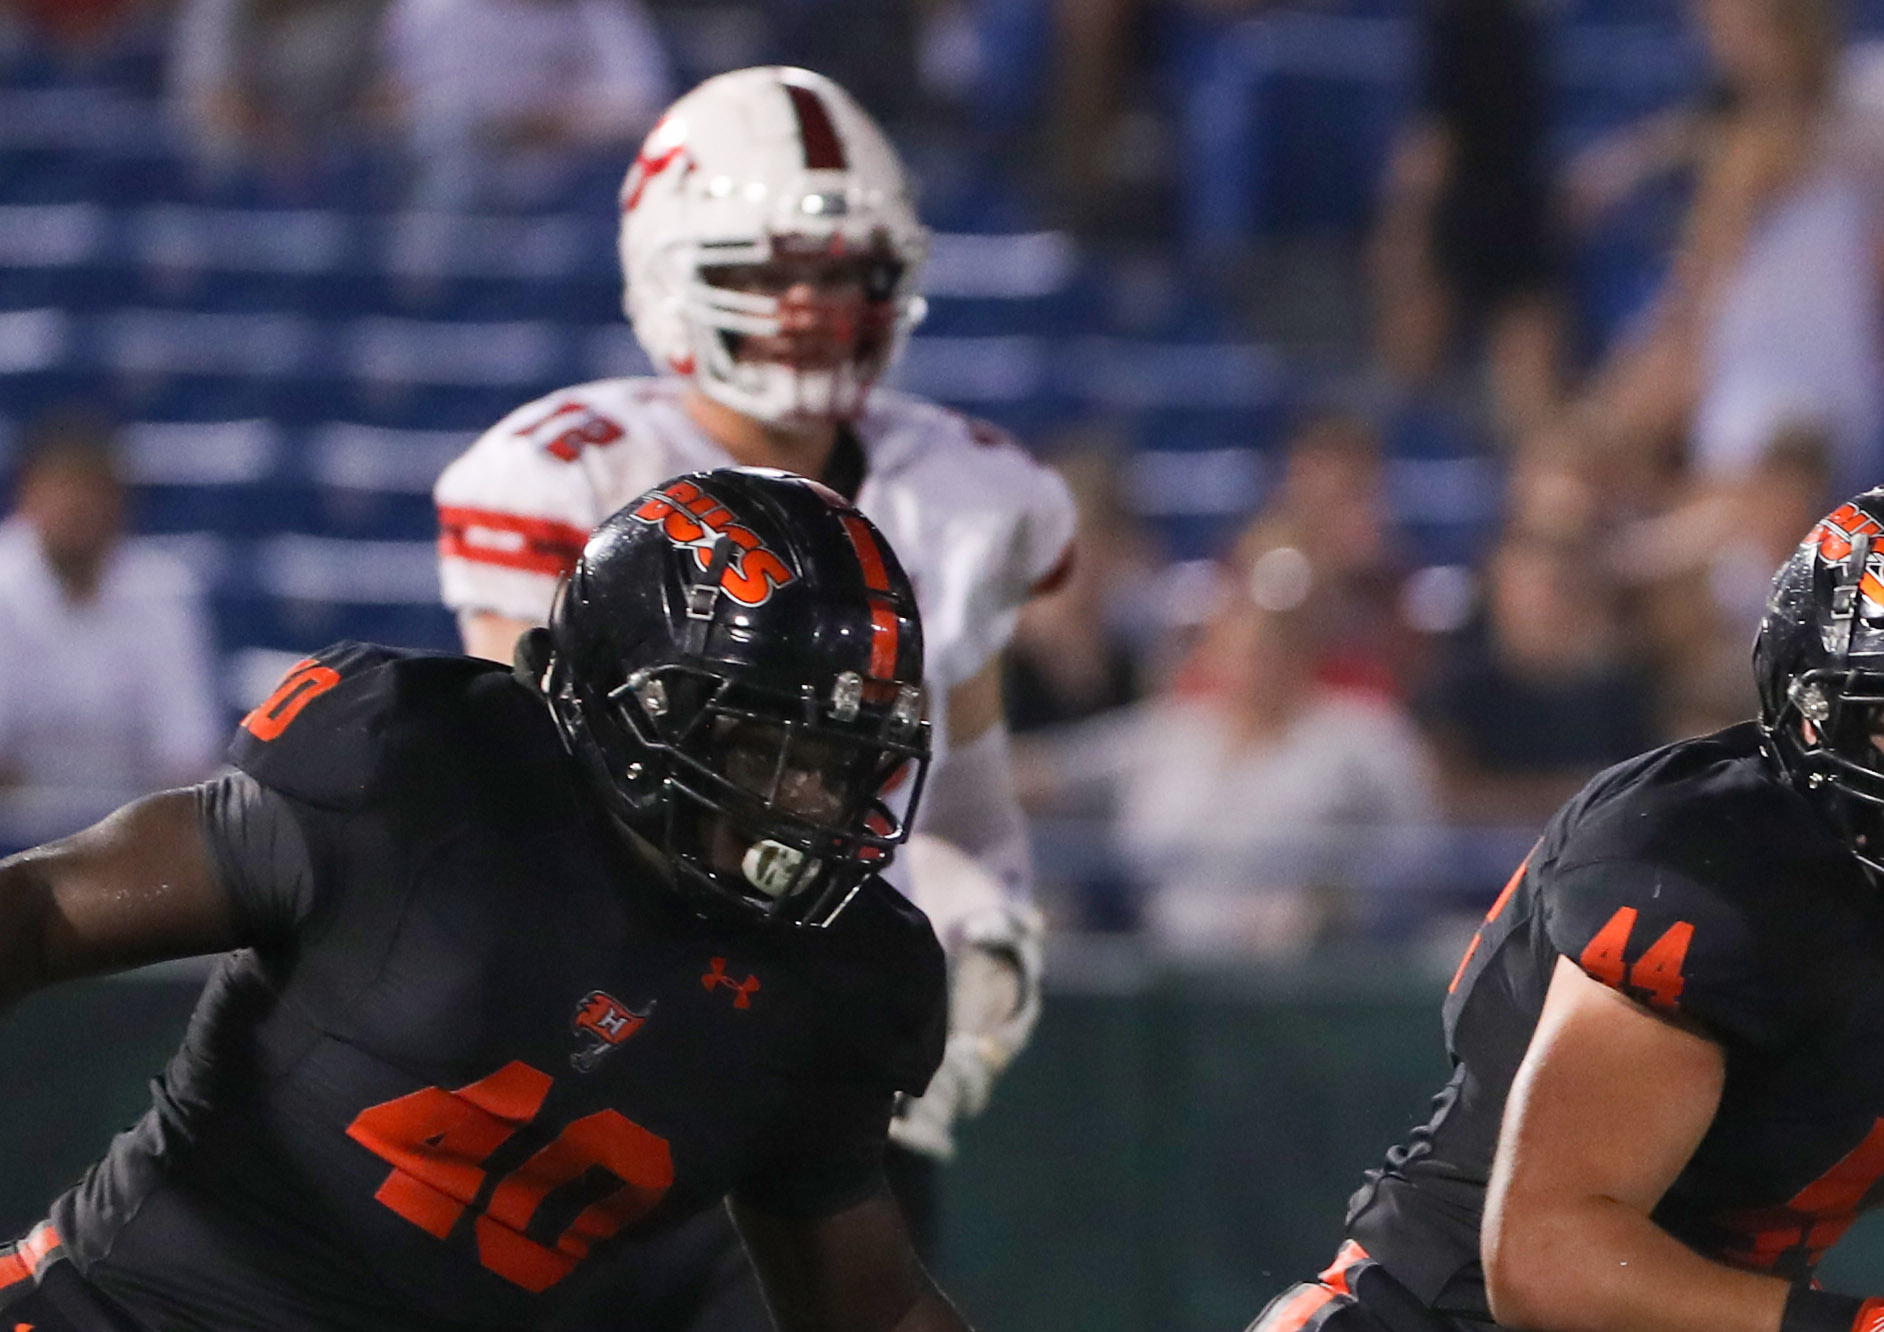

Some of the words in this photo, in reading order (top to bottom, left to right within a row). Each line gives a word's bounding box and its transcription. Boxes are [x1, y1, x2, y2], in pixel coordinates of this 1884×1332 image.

[631, 480, 797, 607] BUCS
[1580, 906, 1696, 1005] 44
[597, 1008, 628, 1036] H
[346, 1061, 675, 1293] 40
